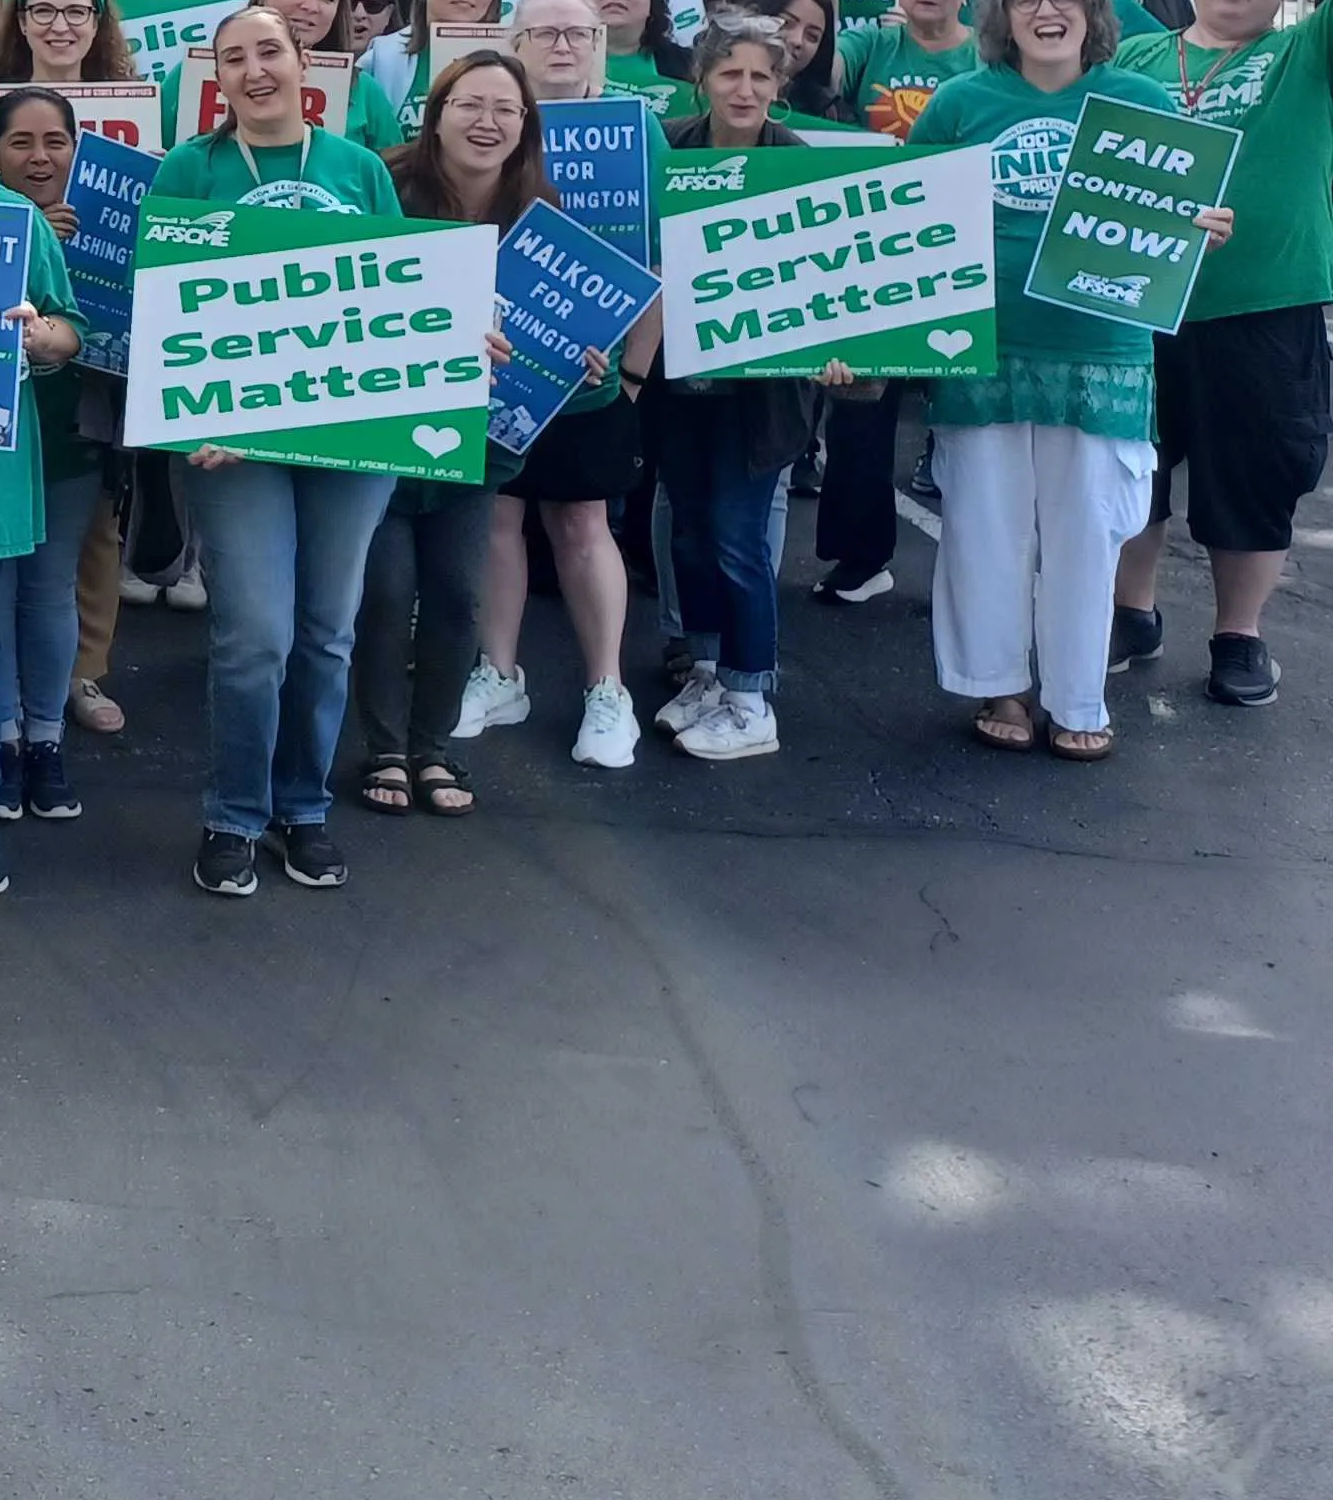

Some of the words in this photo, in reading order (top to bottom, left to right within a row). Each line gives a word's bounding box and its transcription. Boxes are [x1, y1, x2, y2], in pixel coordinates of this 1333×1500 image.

[542, 126, 634, 153] LKOUT
[1016, 130, 1060, 149] 100%
[1092, 130, 1195, 176] FAIR
[78, 160, 147, 206] WALKO
[553, 161, 595, 181] FOR
[665, 175, 745, 192] AFSCME
[701, 178, 927, 254] Public
[1066, 171, 1215, 218] CONTRACT
[99, 206, 131, 234] FOR
[143, 225, 232, 247] AFSCME
[1062, 211, 1190, 263] NOW!
[75, 270, 123, 292] CONTRACT
[178, 251, 424, 314] Public
[512, 228, 636, 317] WALKOUT
[690, 219, 957, 306] Service
[529, 281, 574, 320] FOR
[694, 261, 989, 353] Matters
[1067, 274, 1143, 308] AFSCME
[160, 306, 453, 368] Service
[161, 355, 484, 421] Matters
